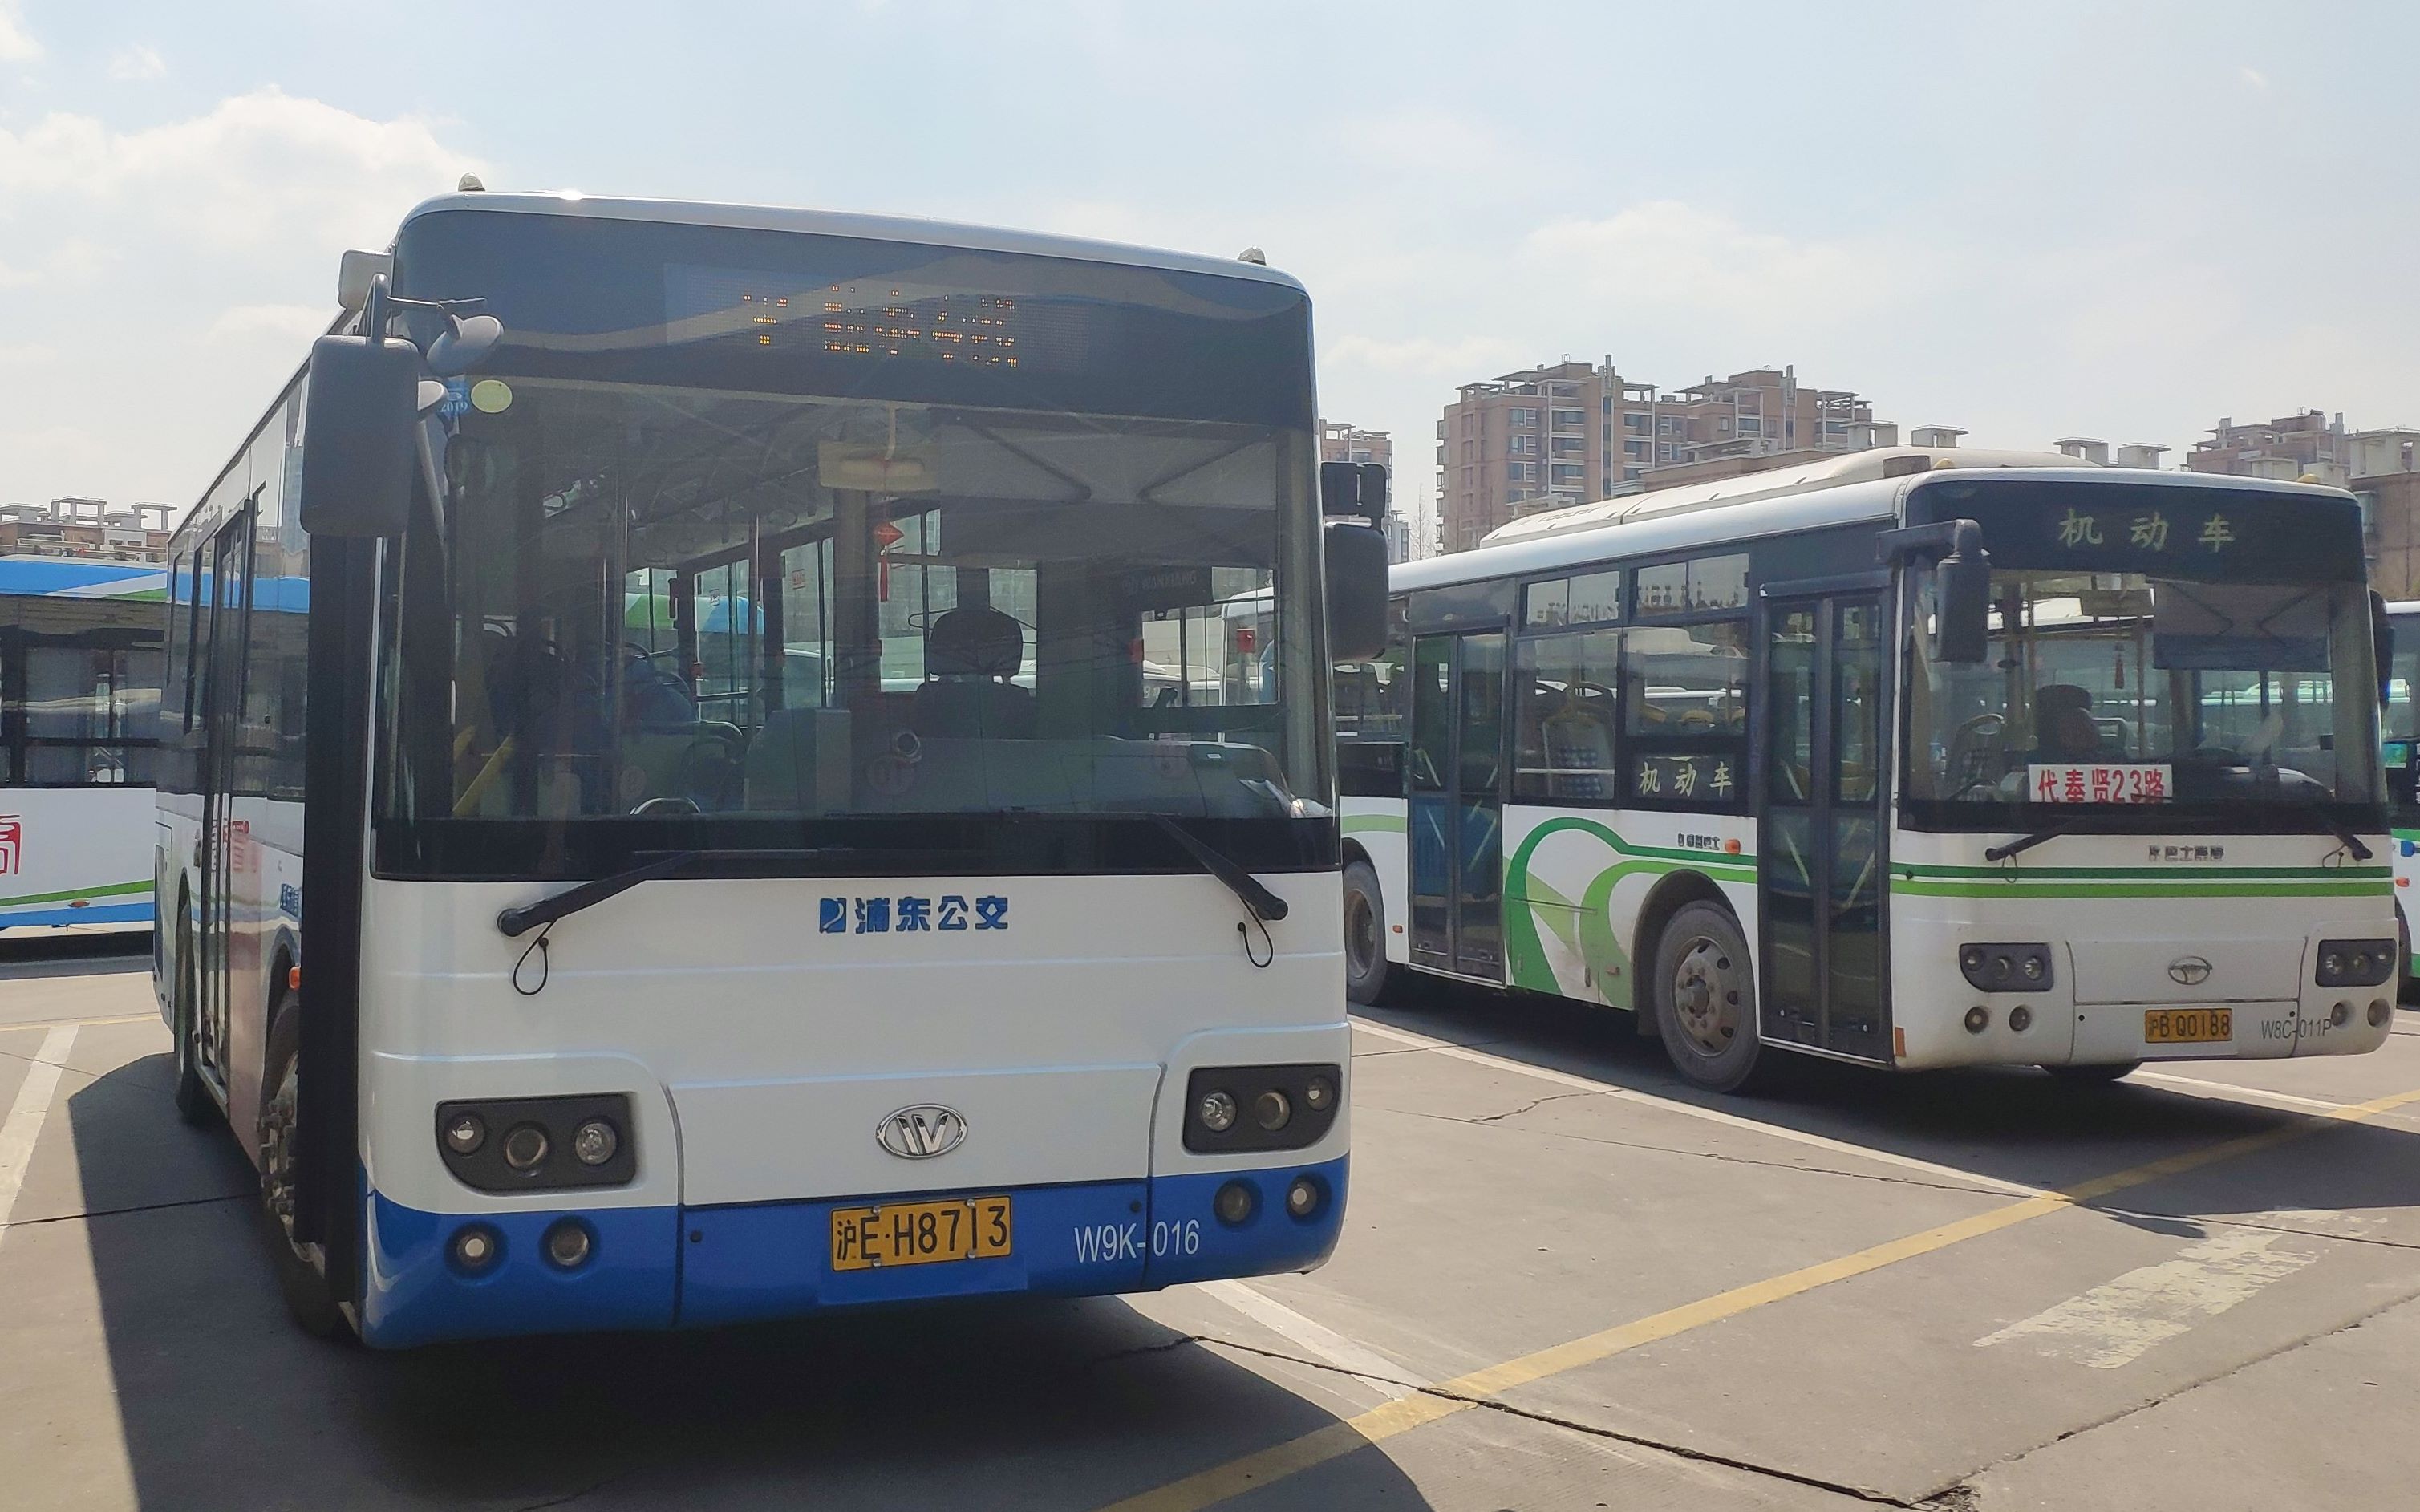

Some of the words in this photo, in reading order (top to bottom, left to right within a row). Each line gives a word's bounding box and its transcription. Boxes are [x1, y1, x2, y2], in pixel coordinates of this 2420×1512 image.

[2057, 508, 2236, 553] 机动车
[1638, 760, 1733, 797] 机动车
[2037, 768, 2166, 803] 代奉贤23路
[854, 894, 1009, 934] 浦东公交
[2260, 1018, 2333, 1040] W8C-011P
[1074, 1219, 1201, 1263] W9K-016
